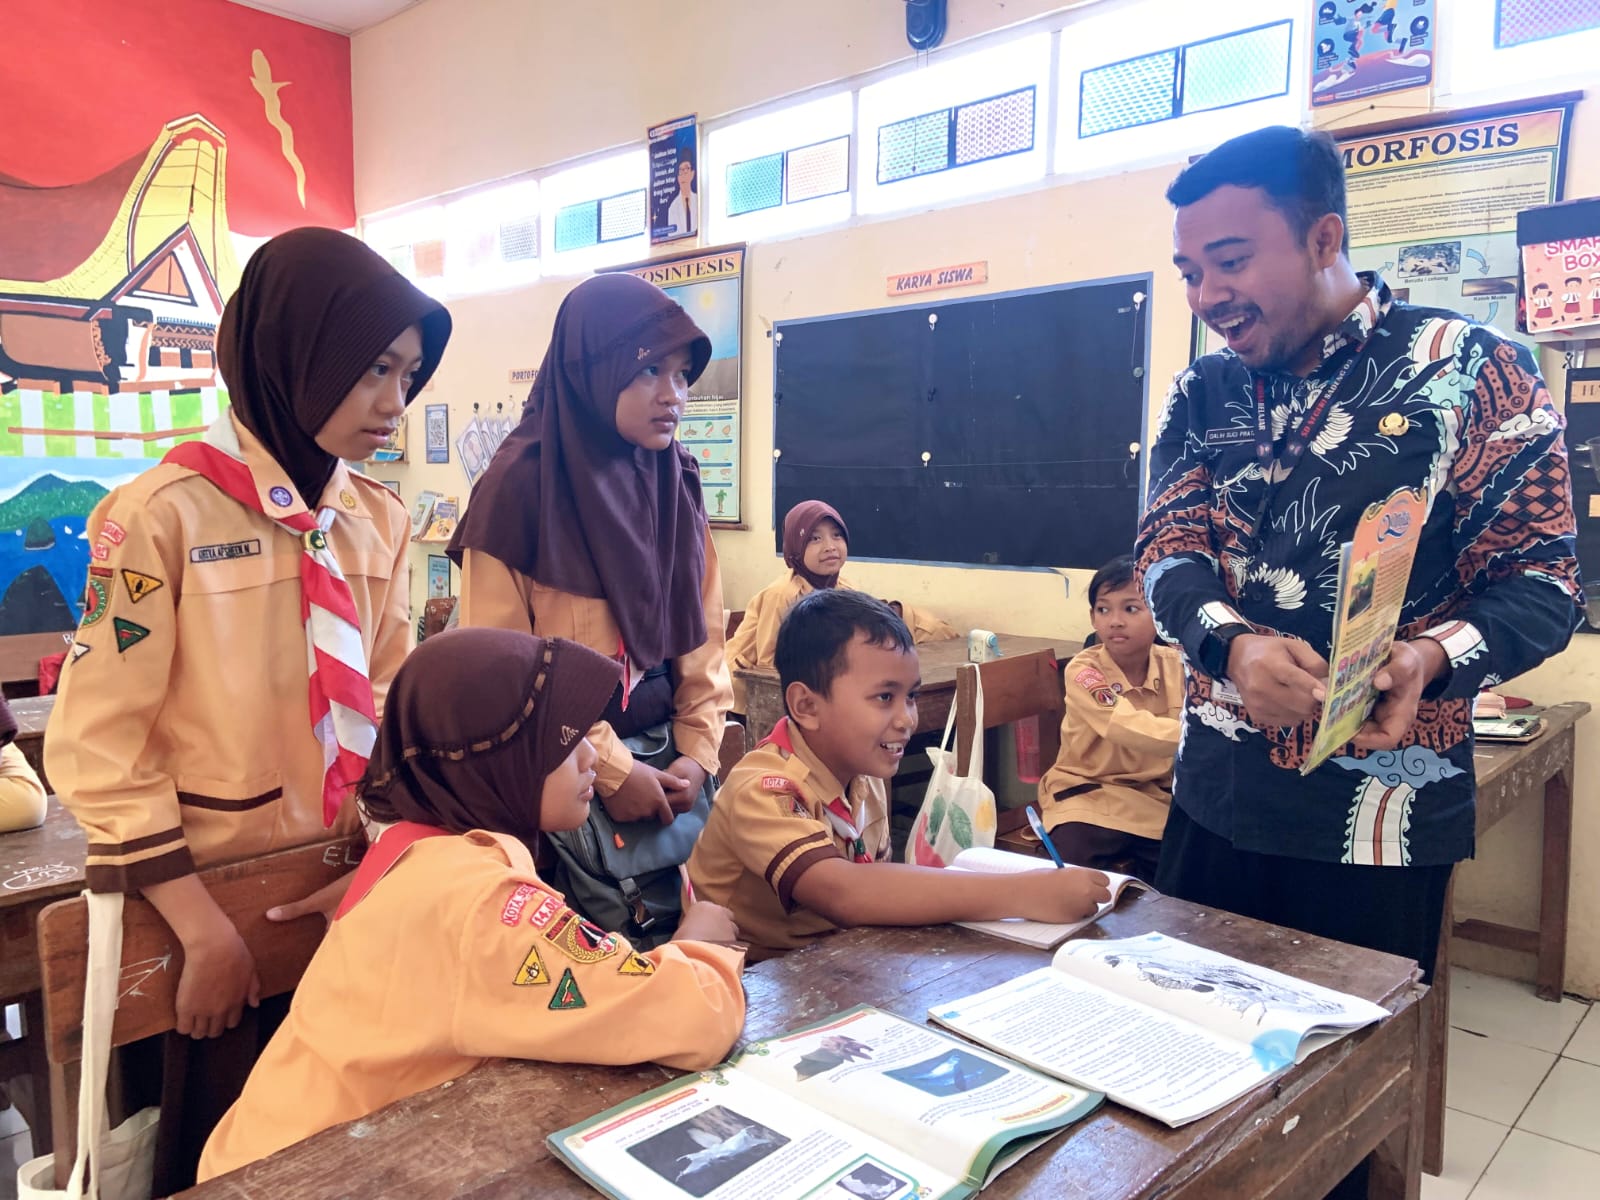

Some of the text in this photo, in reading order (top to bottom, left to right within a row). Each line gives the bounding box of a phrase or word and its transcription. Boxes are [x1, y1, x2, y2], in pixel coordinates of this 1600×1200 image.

[636, 257, 735, 283] OSINTESIS
[896, 267, 973, 291] KARYA SISWA
[503, 899, 523, 924] KOTA
